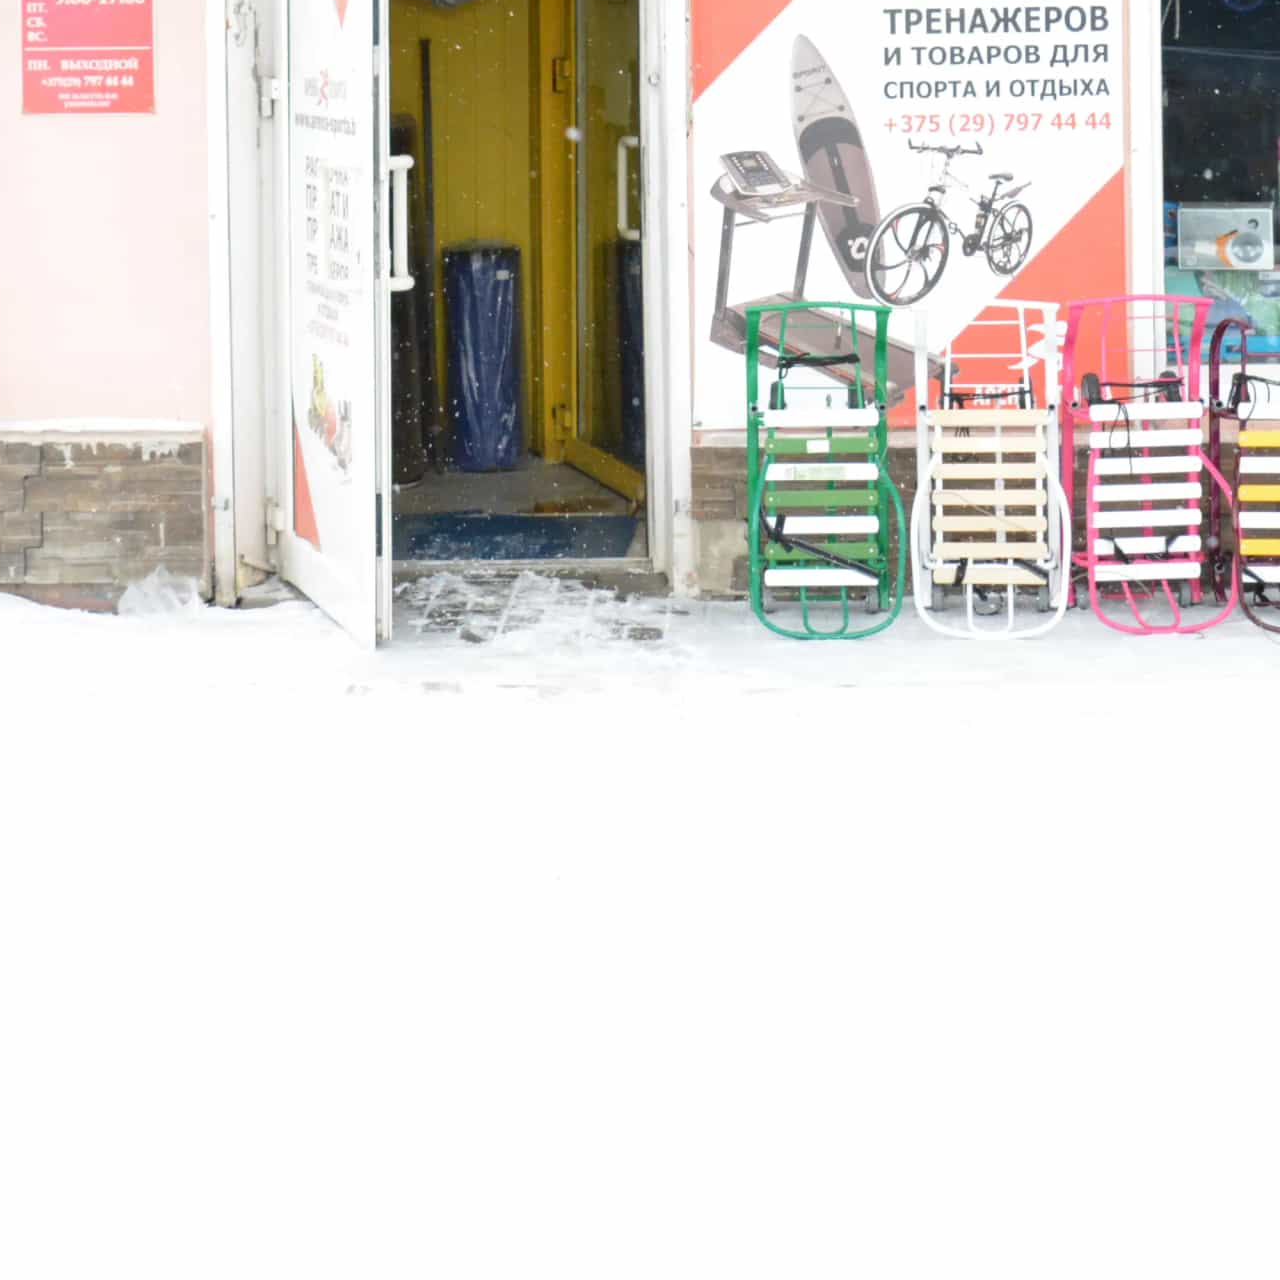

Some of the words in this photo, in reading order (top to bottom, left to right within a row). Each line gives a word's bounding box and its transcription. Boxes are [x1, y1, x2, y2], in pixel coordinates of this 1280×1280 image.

[883, 6, 1110, 35] ТРЕНАЖЕРОВ
[883, 47, 902, 67] И
[911, 45, 1041, 67] ТОВАРОВ
[1049, 43, 1109, 69] ДЛЯ
[883, 80, 977, 100] СПОРТА
[985, 80, 1001, 98] И
[1009, 77, 1110, 101] ОТДЫХА
[884, 114, 941, 134] +375
[948, 113, 995, 136] (29)
[1003, 113, 1043, 132] 797
[1050, 112, 1077, 131] 44
[1085, 111, 1112, 130] 44
